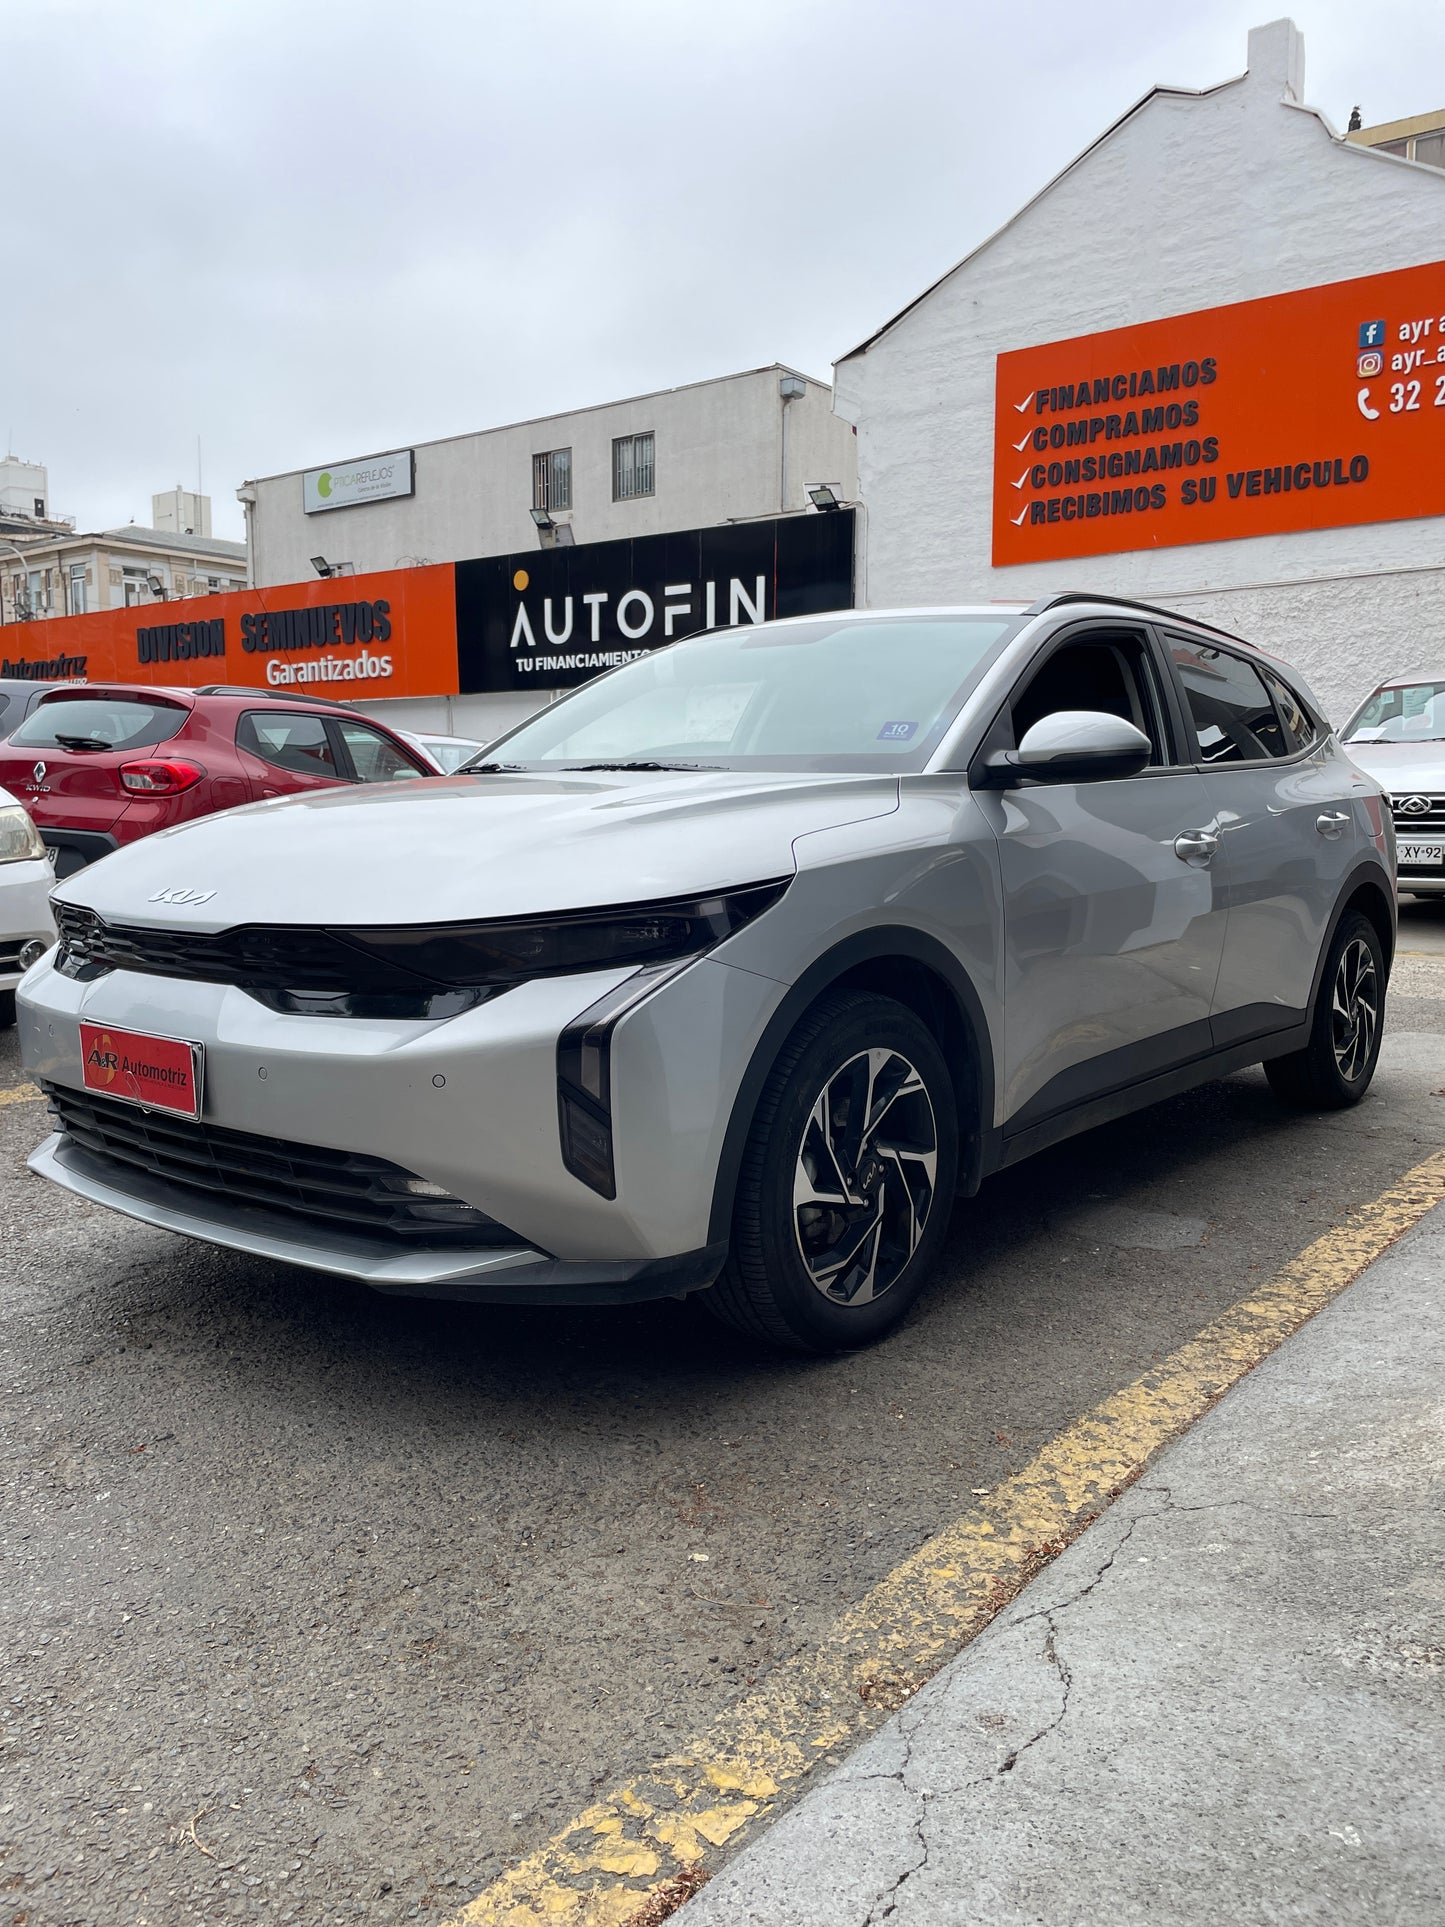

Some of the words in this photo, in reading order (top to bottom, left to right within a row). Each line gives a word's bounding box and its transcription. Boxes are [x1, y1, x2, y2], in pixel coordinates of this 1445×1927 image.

[1399, 318, 1434, 344] ayr
[1035, 357, 1217, 414] FINANCIAMOS
[1389, 380, 1421, 413] 32
[1032, 400, 1199, 451] COMPRAMOS
[1030, 436, 1219, 489] CONSIGNAMOS
[1030, 483, 1166, 525] RECIBIMOS
[1181, 475, 1216, 504] SU
[1226, 454, 1369, 498] VEHICULO
[137, 618, 225, 664] DIVISION
[240, 599, 392, 652] SEMINUEVOS
[510, 576, 766, 648] AUTOFIN
[1, 652, 88, 680] Automotriz
[266, 649, 393, 686] Garantizados
[516, 657, 533, 672] TU
[121, 1056, 187, 1087] Automotriz
